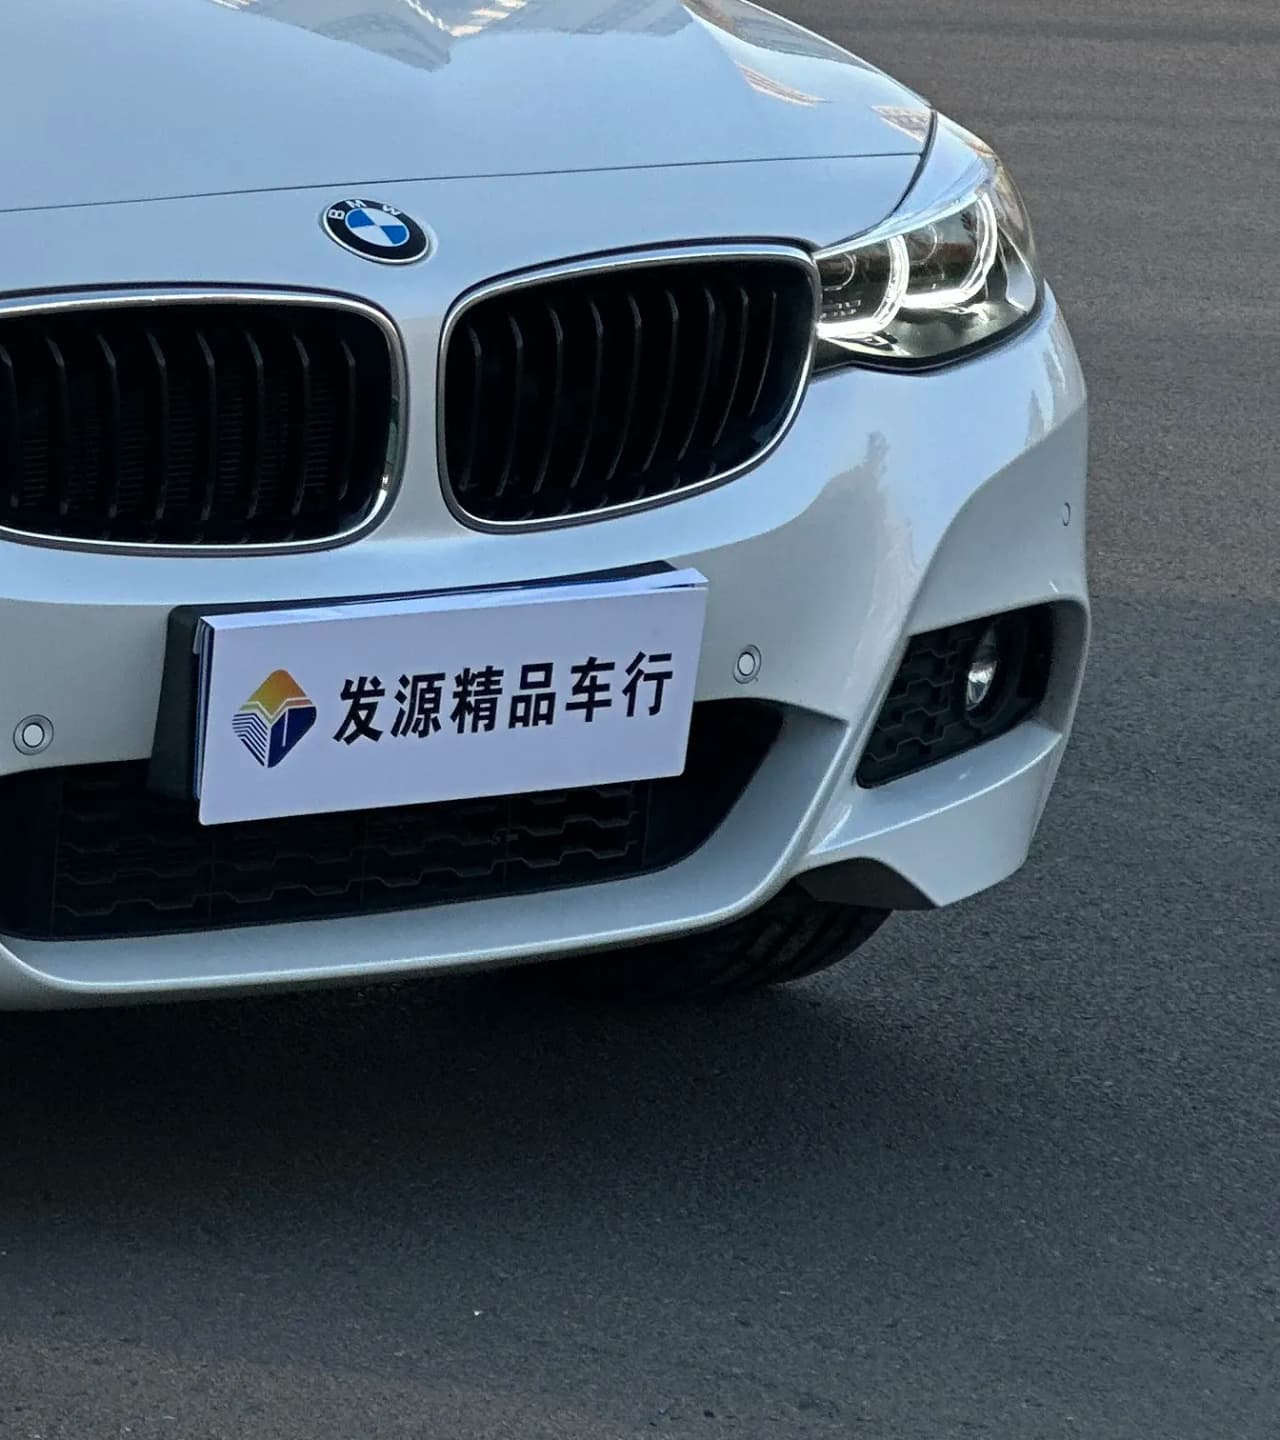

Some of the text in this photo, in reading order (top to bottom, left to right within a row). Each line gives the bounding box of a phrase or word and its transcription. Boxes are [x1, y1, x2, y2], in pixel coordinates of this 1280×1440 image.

[327, 199, 401, 220] BMW
[333, 651, 673, 746] 发源精品车行
